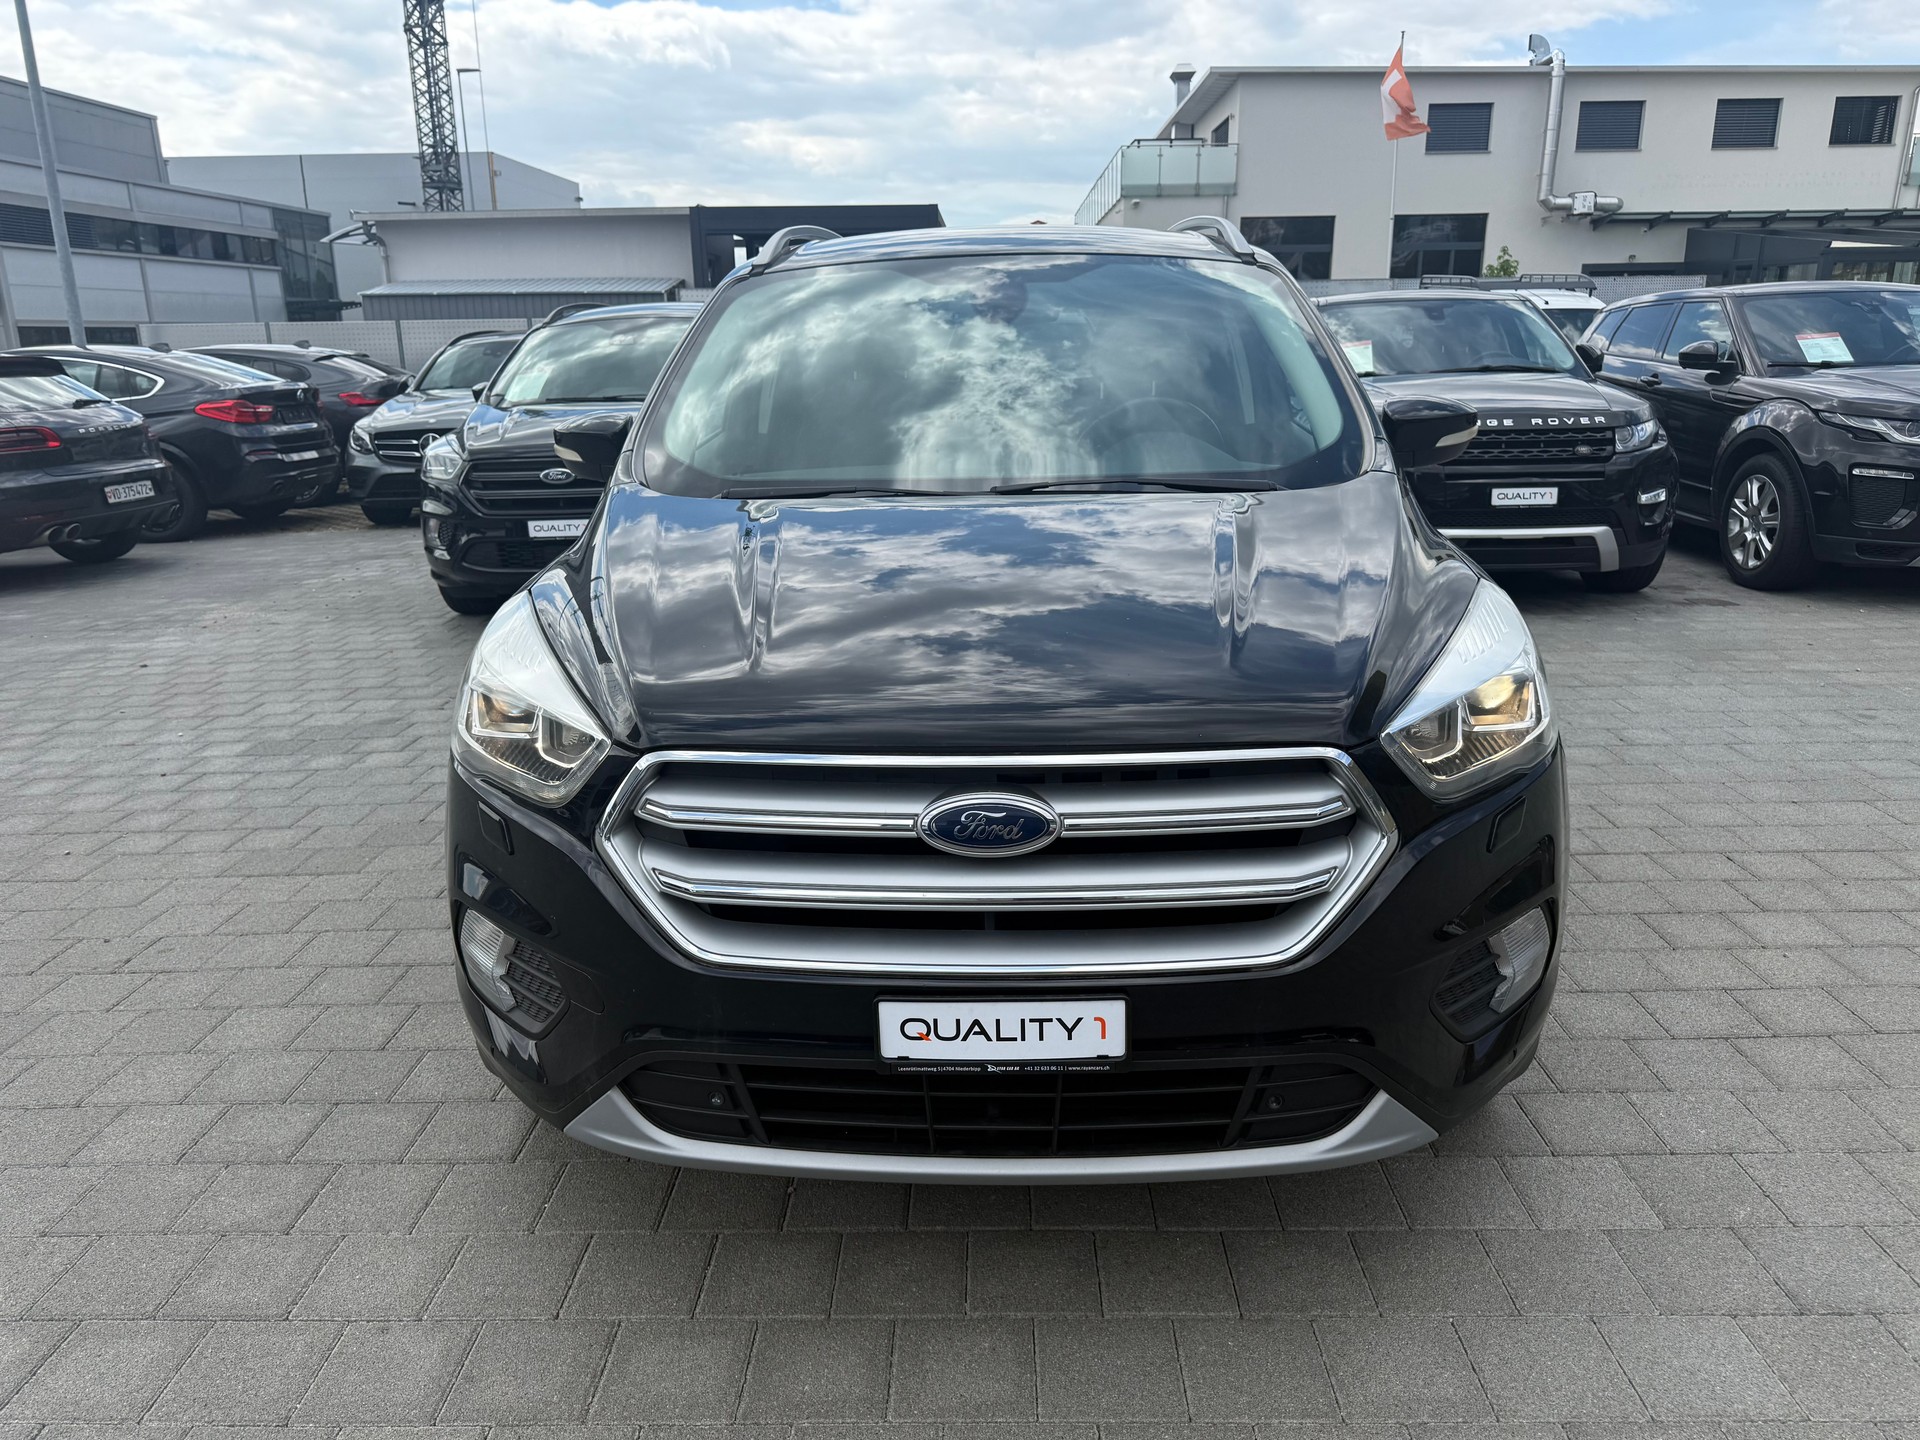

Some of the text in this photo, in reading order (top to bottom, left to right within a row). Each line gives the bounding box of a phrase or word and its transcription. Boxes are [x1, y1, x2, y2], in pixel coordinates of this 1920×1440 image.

[1531, 416, 1606, 426] ROVER
[78, 424, 131, 434] PORSCHE
[547, 471, 567, 480] Ford
[1496, 491, 1553, 501] QUALITY 1
[533, 523, 581, 532] QUALITY
[953, 810, 1025, 840] Ford
[899, 1016, 1107, 1042] QUALITY 1
